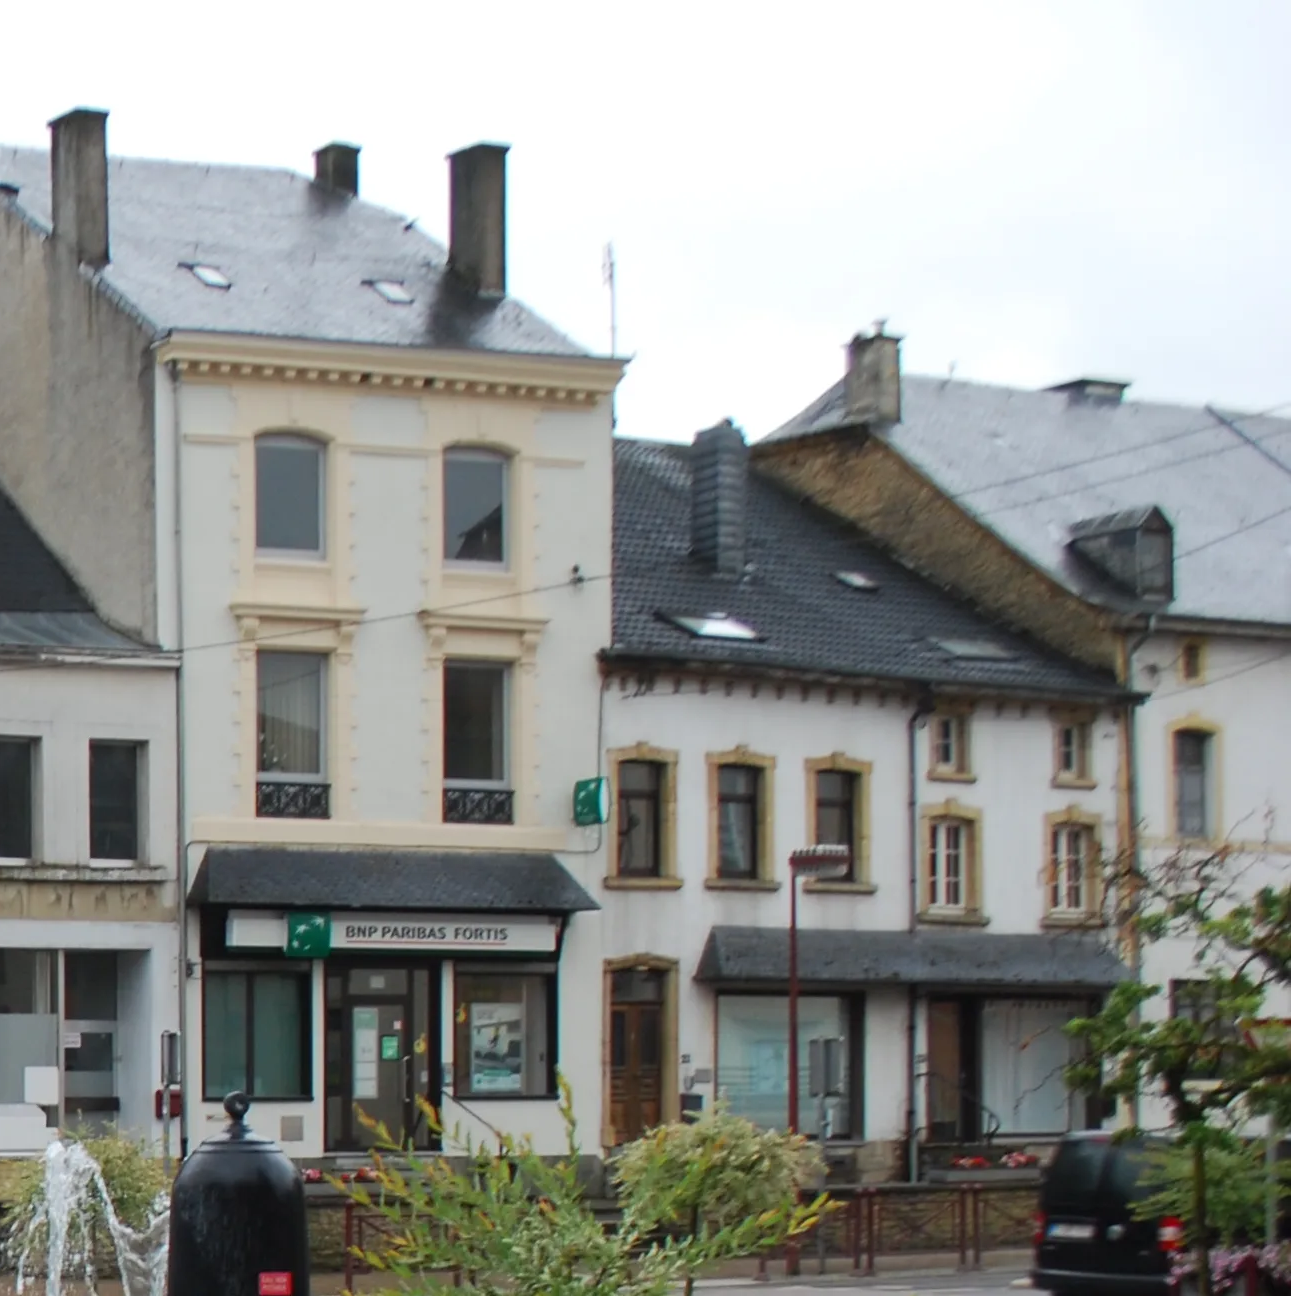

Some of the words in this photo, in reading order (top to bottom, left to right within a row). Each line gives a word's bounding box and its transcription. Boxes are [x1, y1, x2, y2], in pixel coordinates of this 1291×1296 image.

[345, 925, 379, 939] BNP
[381, 926, 447, 940] PARIBAS
[454, 927, 508, 941] FORTIS
